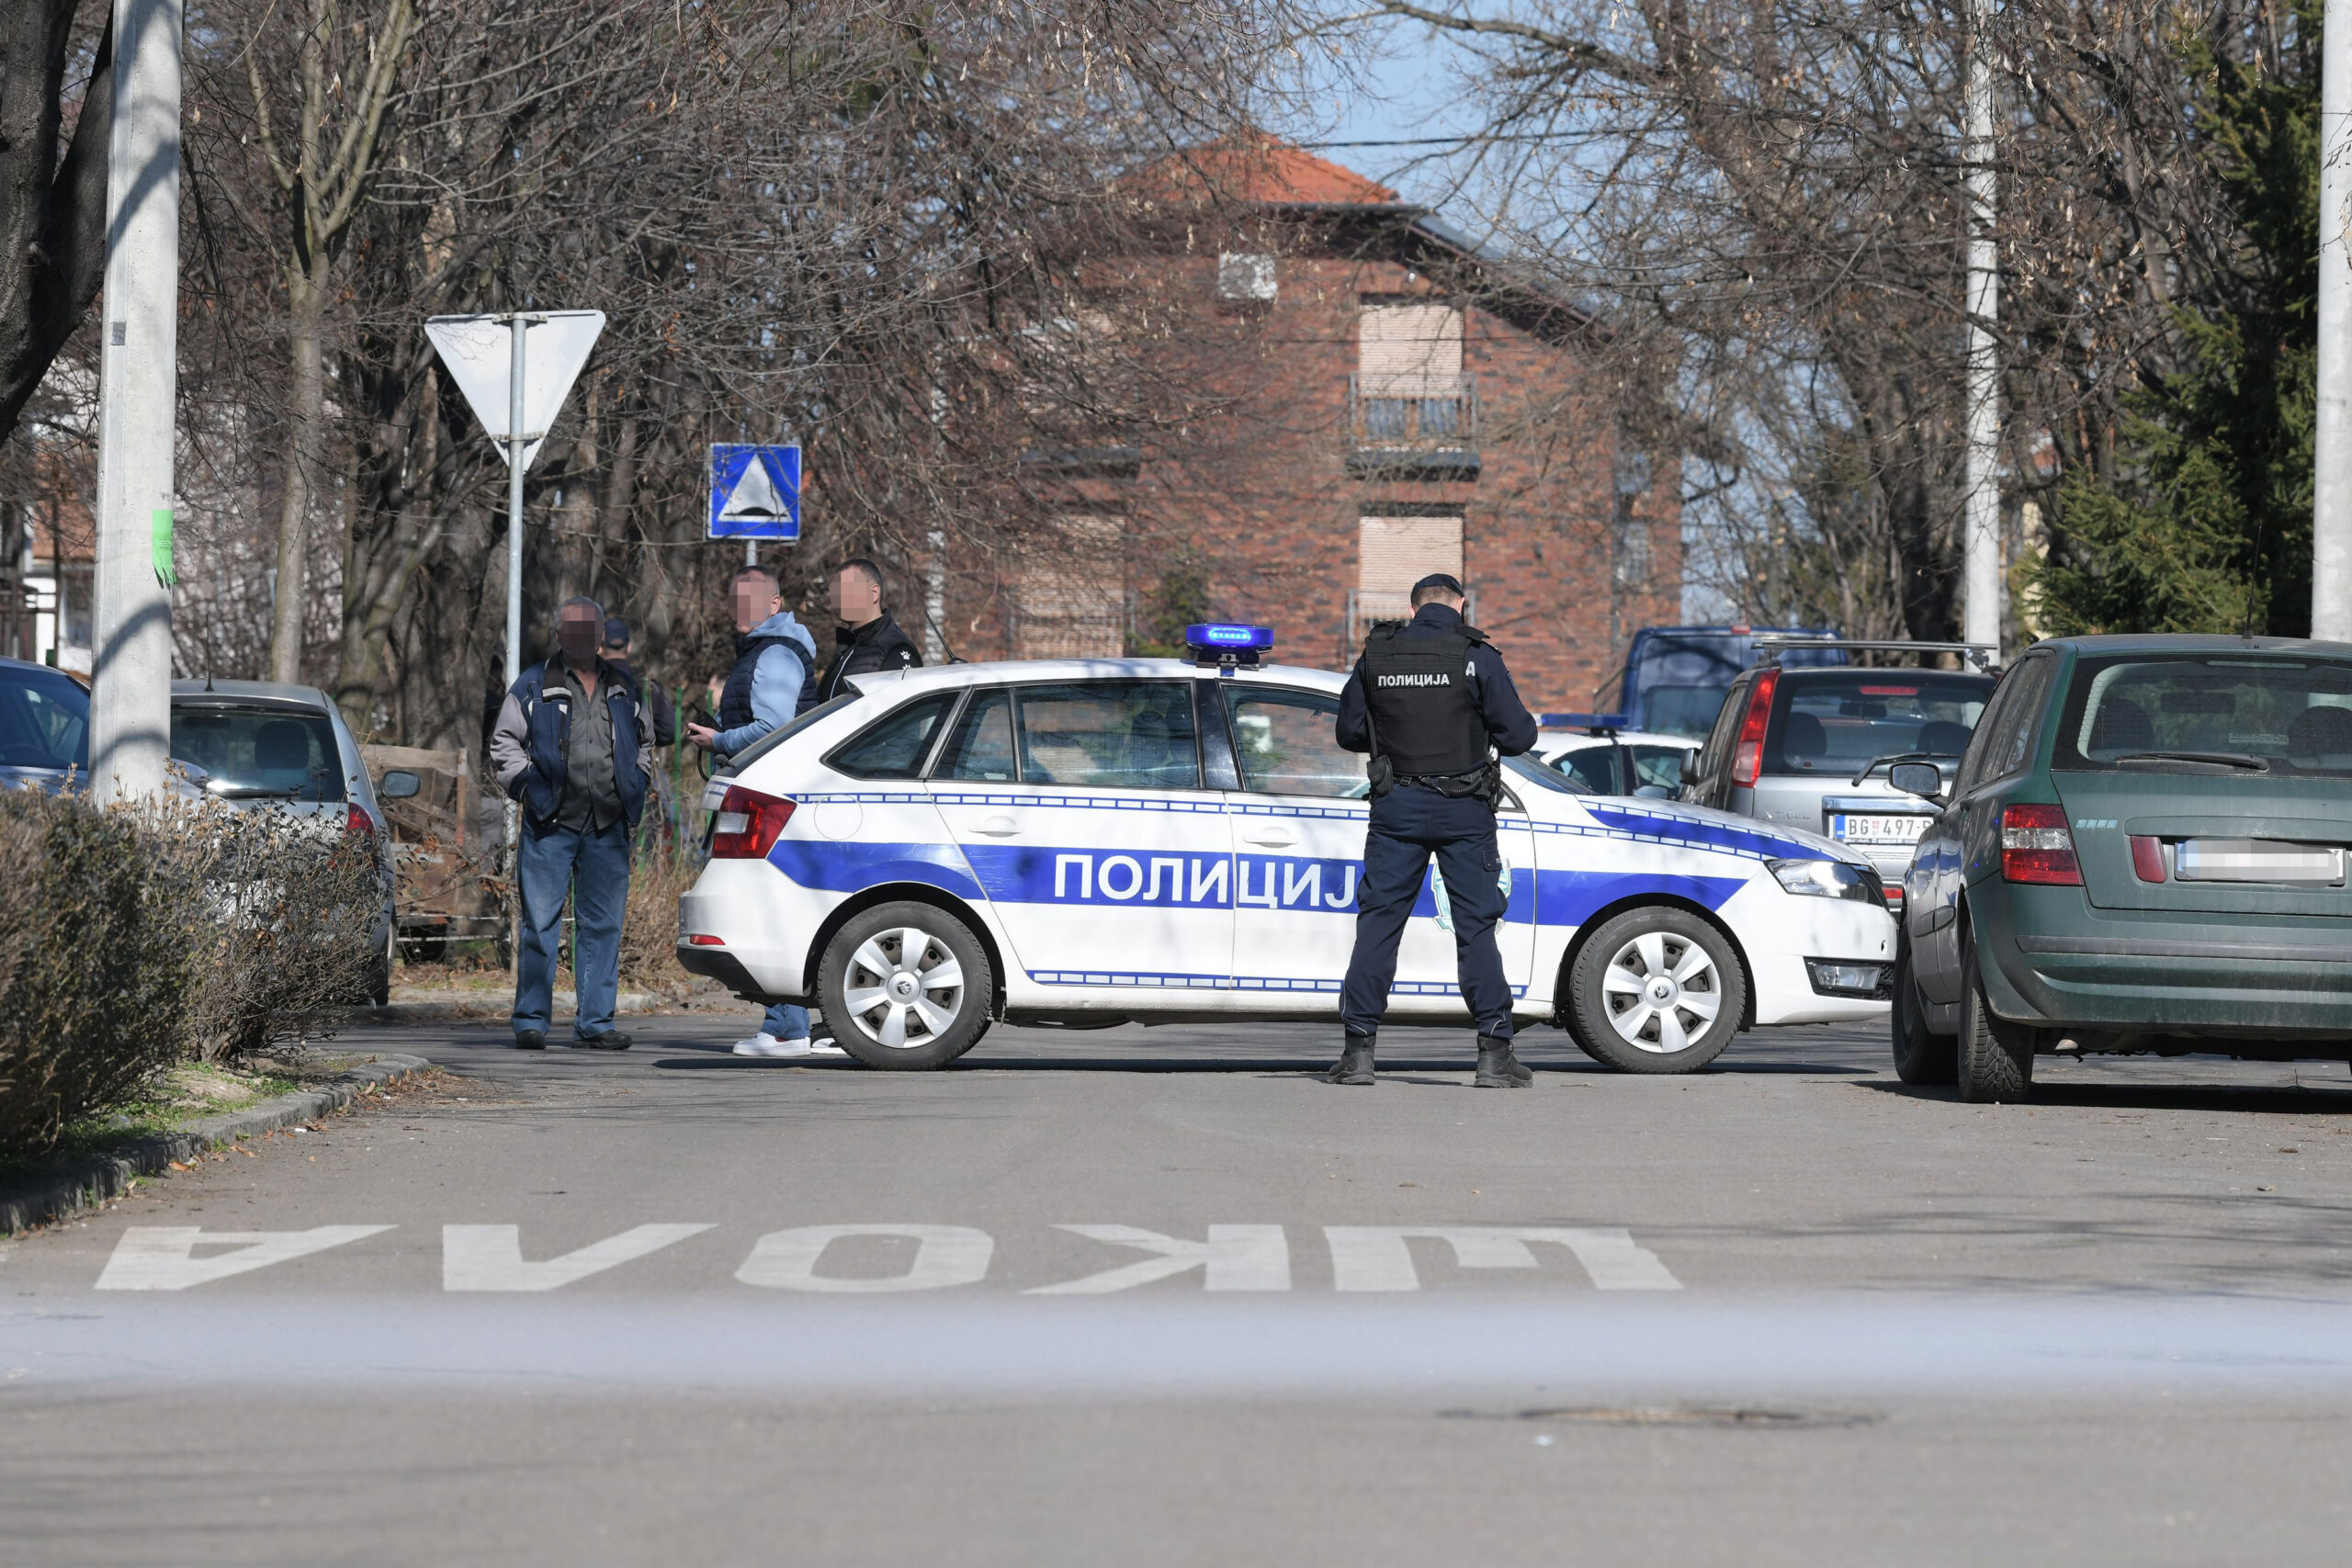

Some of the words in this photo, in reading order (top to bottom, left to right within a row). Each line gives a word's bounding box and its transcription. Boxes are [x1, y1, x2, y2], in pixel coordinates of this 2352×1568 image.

[1378, 673, 1450, 687] ПОЛИЦИЈА
[1849, 818, 1869, 835] BG
[1055, 853, 1356, 909] ПОЛИЦИЈ
